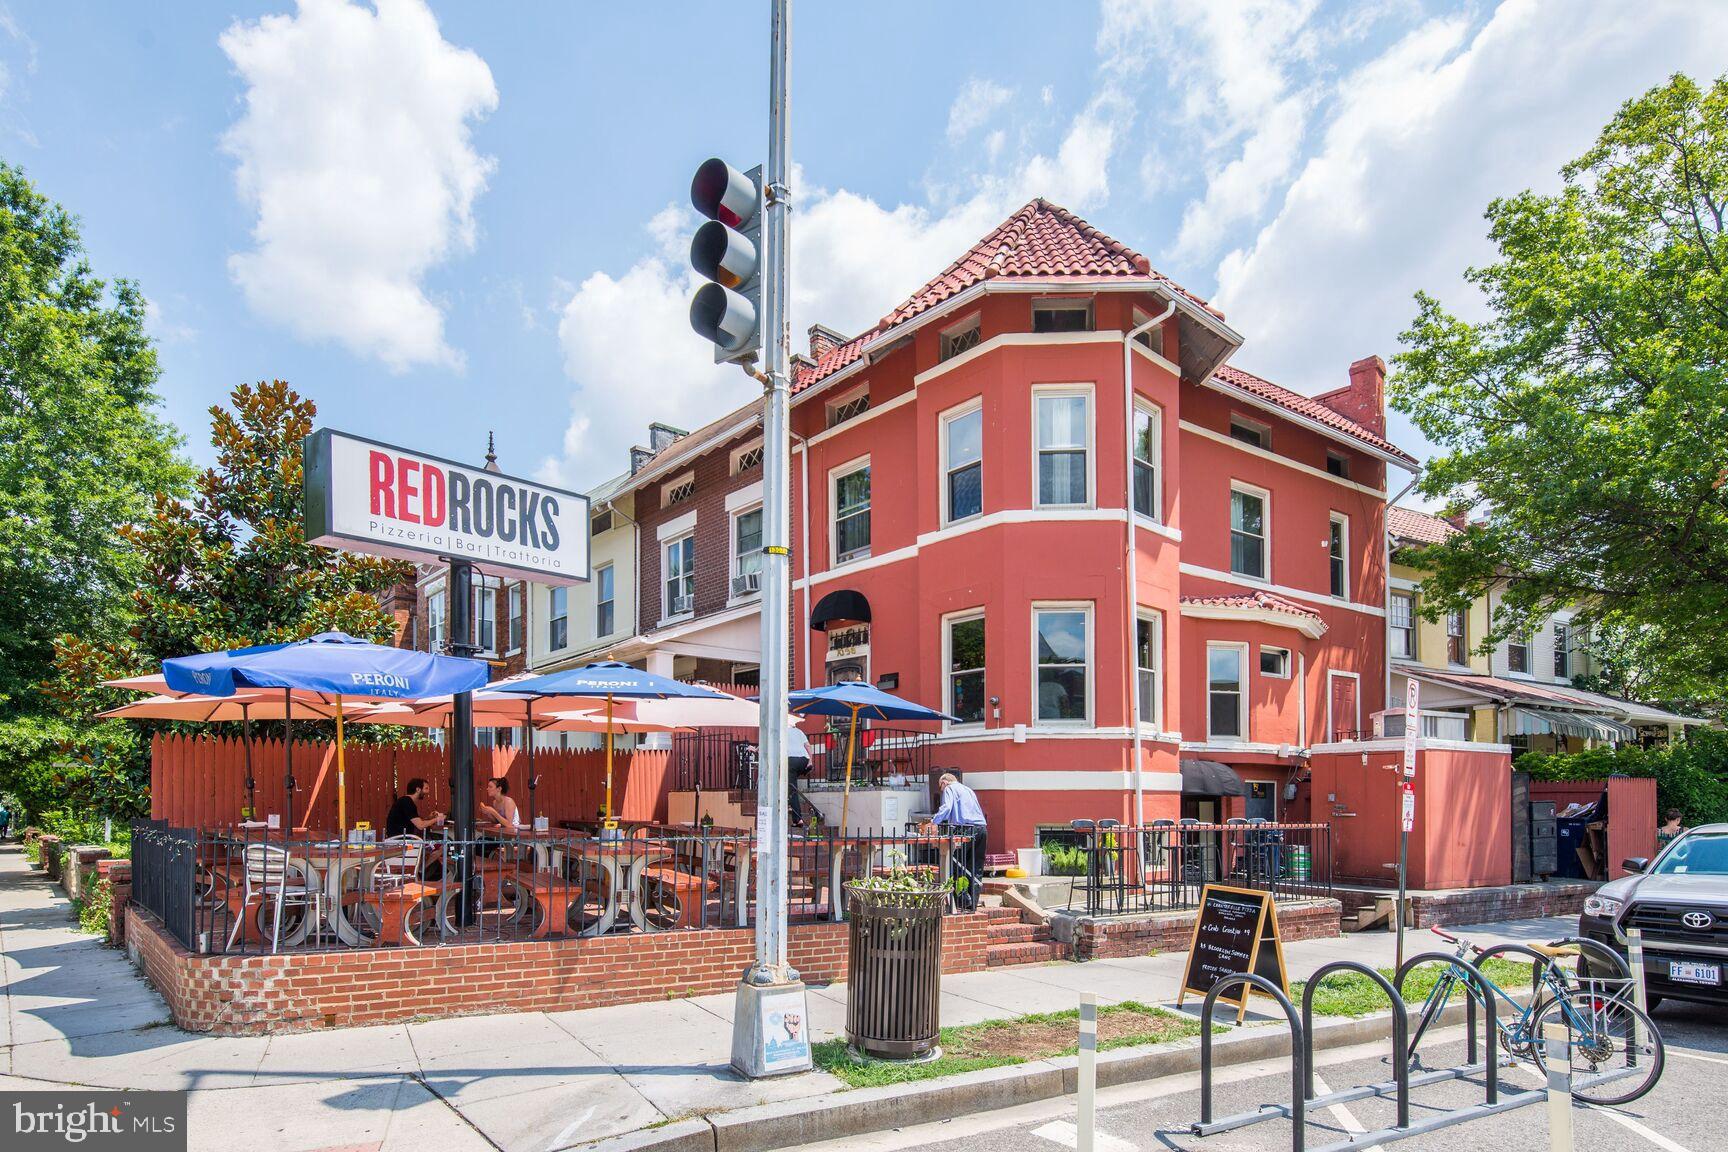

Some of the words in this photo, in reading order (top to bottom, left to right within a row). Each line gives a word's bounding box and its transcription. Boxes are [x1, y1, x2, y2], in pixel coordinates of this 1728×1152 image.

[369, 450, 560, 552] REDROCKS
[351, 672, 410, 690] PERONI
[576, 679, 638, 687] PERONI
[370, 688, 399, 697] ITALY
[1671, 965, 1683, 976] FF
[1695, 968, 1716, 980] 6101
